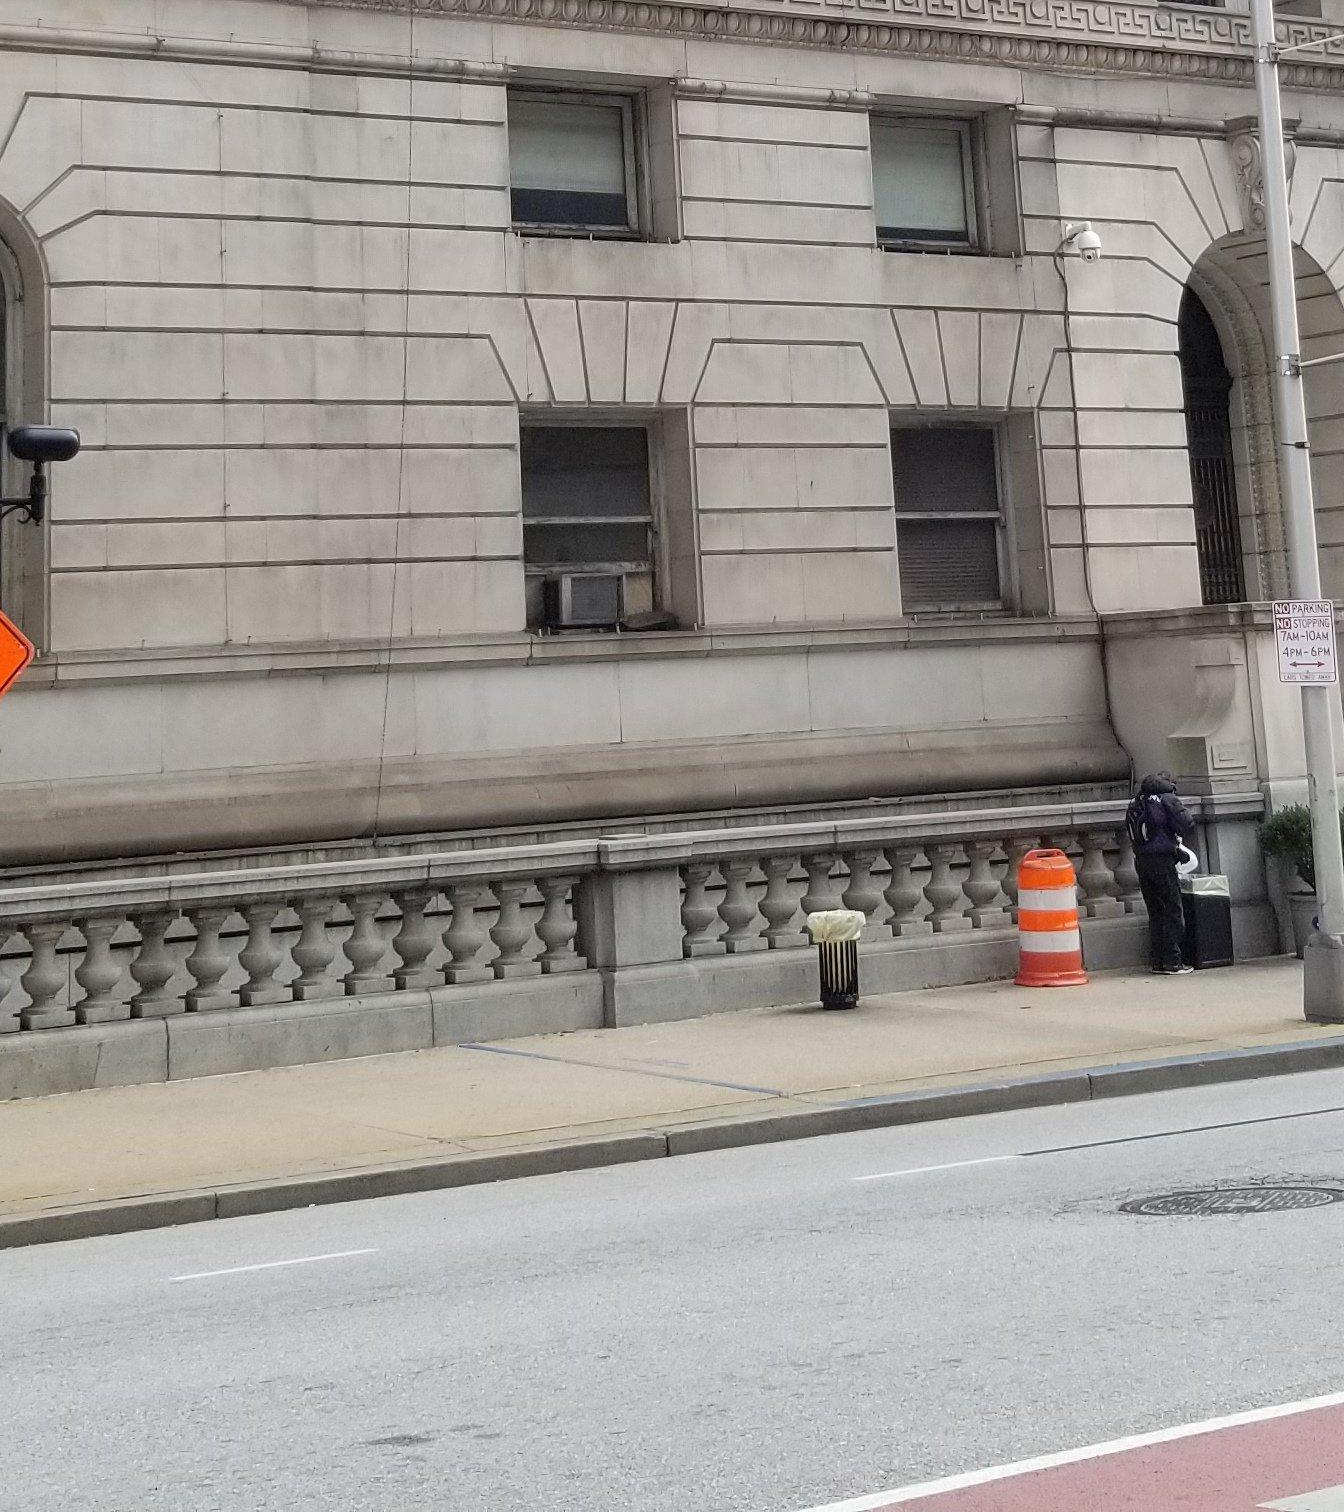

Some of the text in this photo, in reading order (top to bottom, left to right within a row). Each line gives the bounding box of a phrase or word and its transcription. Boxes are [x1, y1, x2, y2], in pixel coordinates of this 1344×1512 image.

[1275, 602, 1330, 614] NO PARKING
[1277, 617, 1331, 629] NO STOPPING
